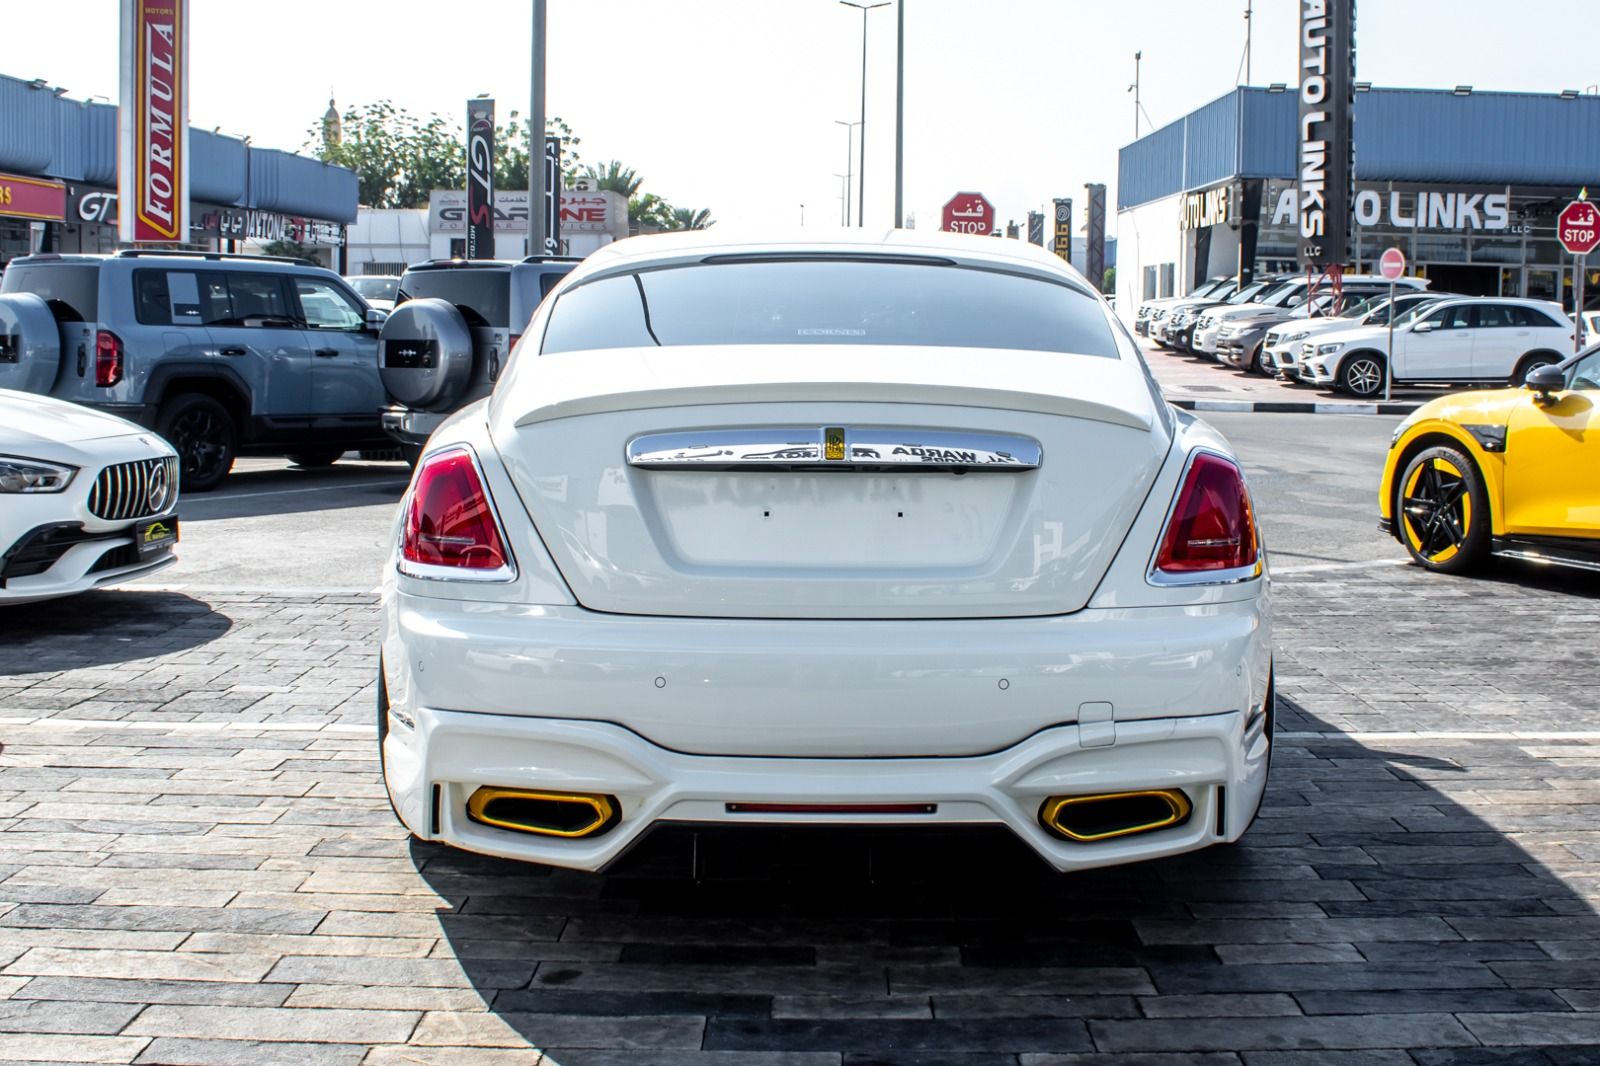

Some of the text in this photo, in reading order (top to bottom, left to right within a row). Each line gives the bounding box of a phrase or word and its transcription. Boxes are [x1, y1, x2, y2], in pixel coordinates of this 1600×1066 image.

[145, 7, 174, 16] MOTORS
[145, 21, 173, 226] FORMULA
[1300, 0, 1326, 238] AUTO LINKS
[952, 199, 984, 217] قف
[1200, 187, 1227, 229] LINKS
[1390, 191, 1509, 230] LINKS
[1566, 209, 1594, 226] قف
[1511, 225, 1531, 234] LLC
[1564, 229, 1595, 243] STOP
[1304, 246, 1321, 257] LLC
